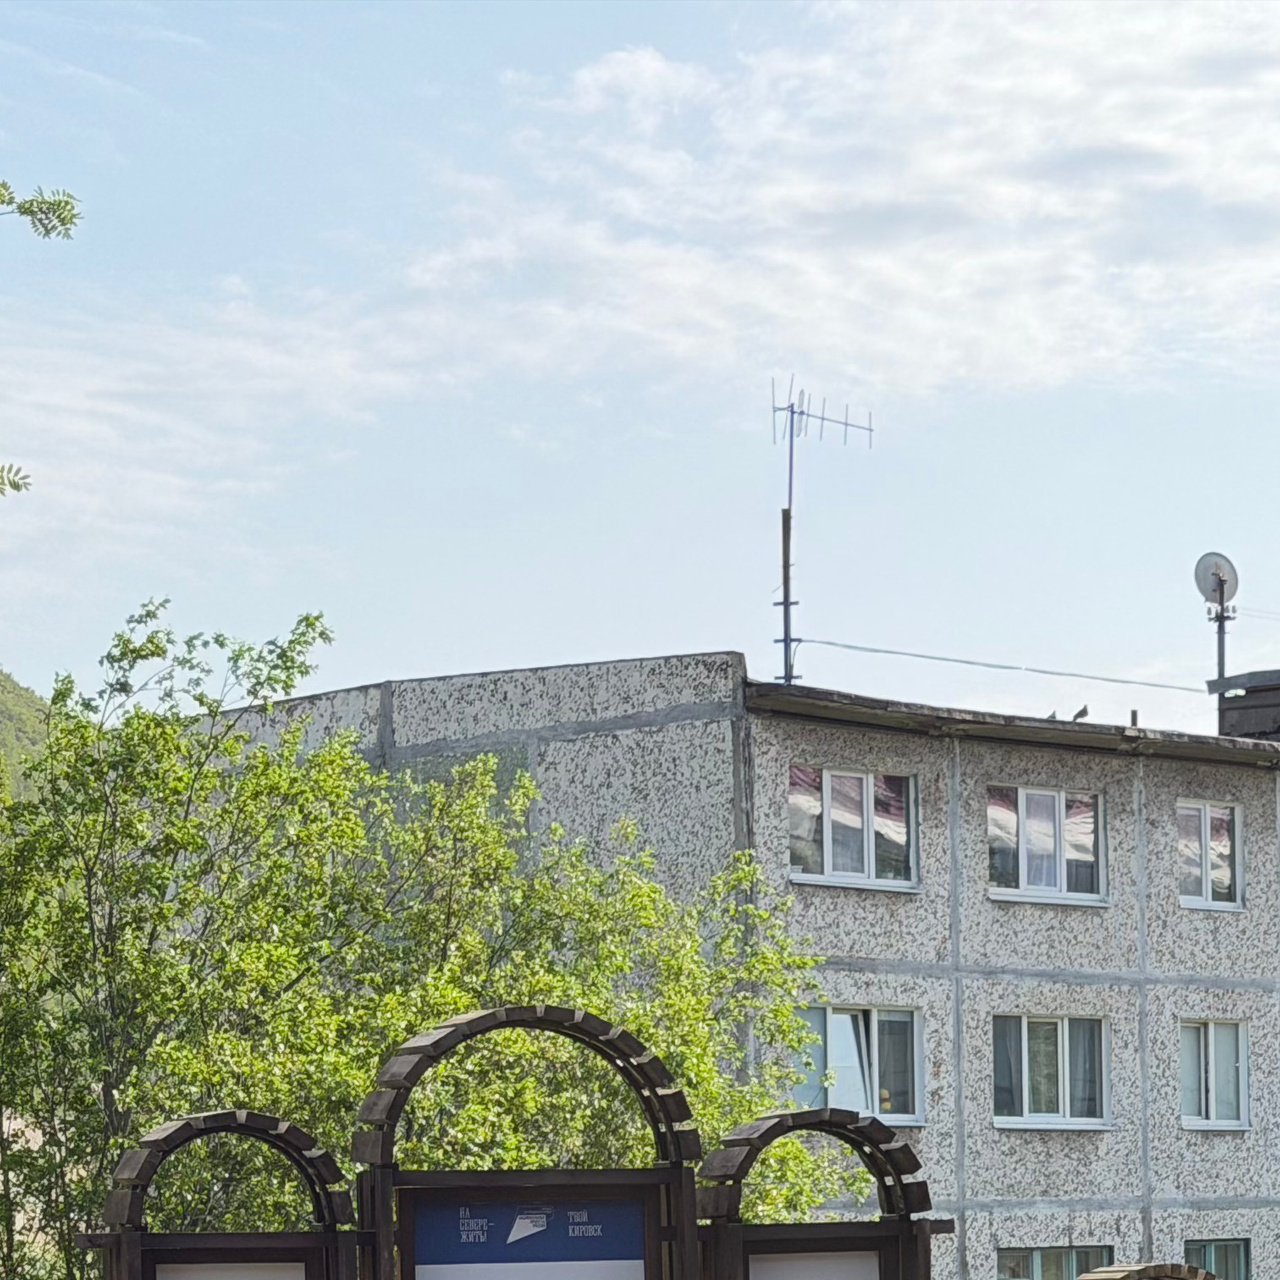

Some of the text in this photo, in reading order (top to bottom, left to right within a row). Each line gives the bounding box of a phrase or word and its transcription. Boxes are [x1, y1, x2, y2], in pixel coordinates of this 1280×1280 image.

[459, 1207, 470, 1219] НА
[567, 1210, 588, 1223] ТВОЙ
[568, 1225, 603, 1237] КИРОВСК
